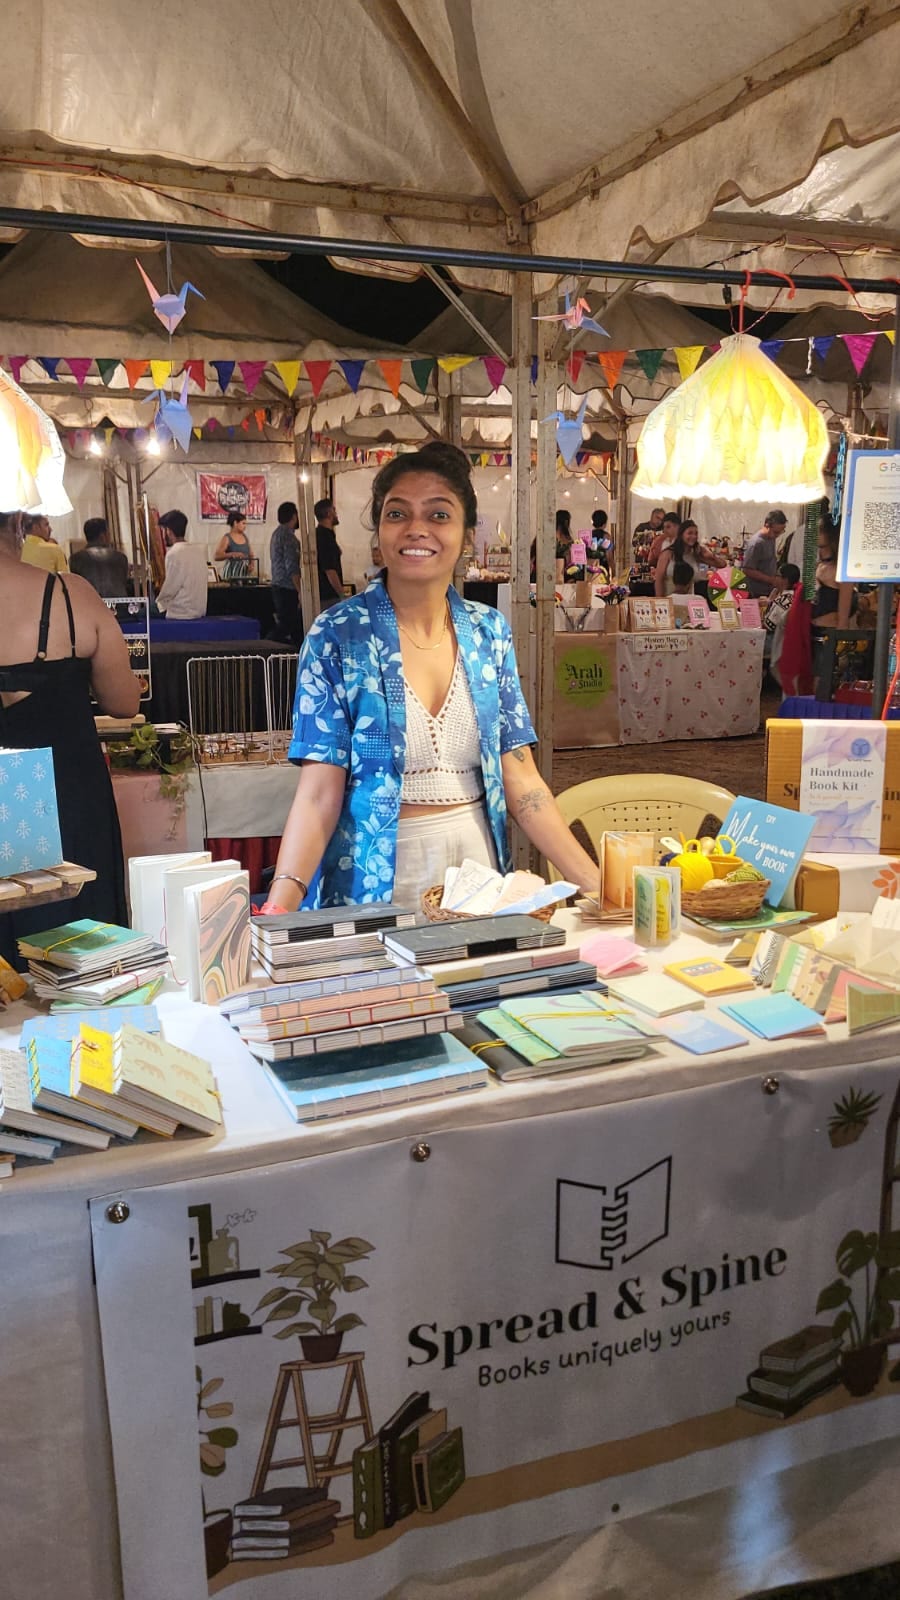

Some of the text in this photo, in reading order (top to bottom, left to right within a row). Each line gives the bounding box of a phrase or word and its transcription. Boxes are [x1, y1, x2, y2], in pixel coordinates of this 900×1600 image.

[565, 663, 603, 680] Arali
[809, 767, 874, 778] Handmade
[809, 781, 859, 791] Book Kit
[766, 814, 777, 825] DIY
[727, 811, 759, 850] Make
[755, 841, 796, 861] your own
[762, 857, 788, 874] BOOK
[407, 1247, 787, 1370] Spread & Spine
[478, 1310, 732, 1387] Books uniquely yours
